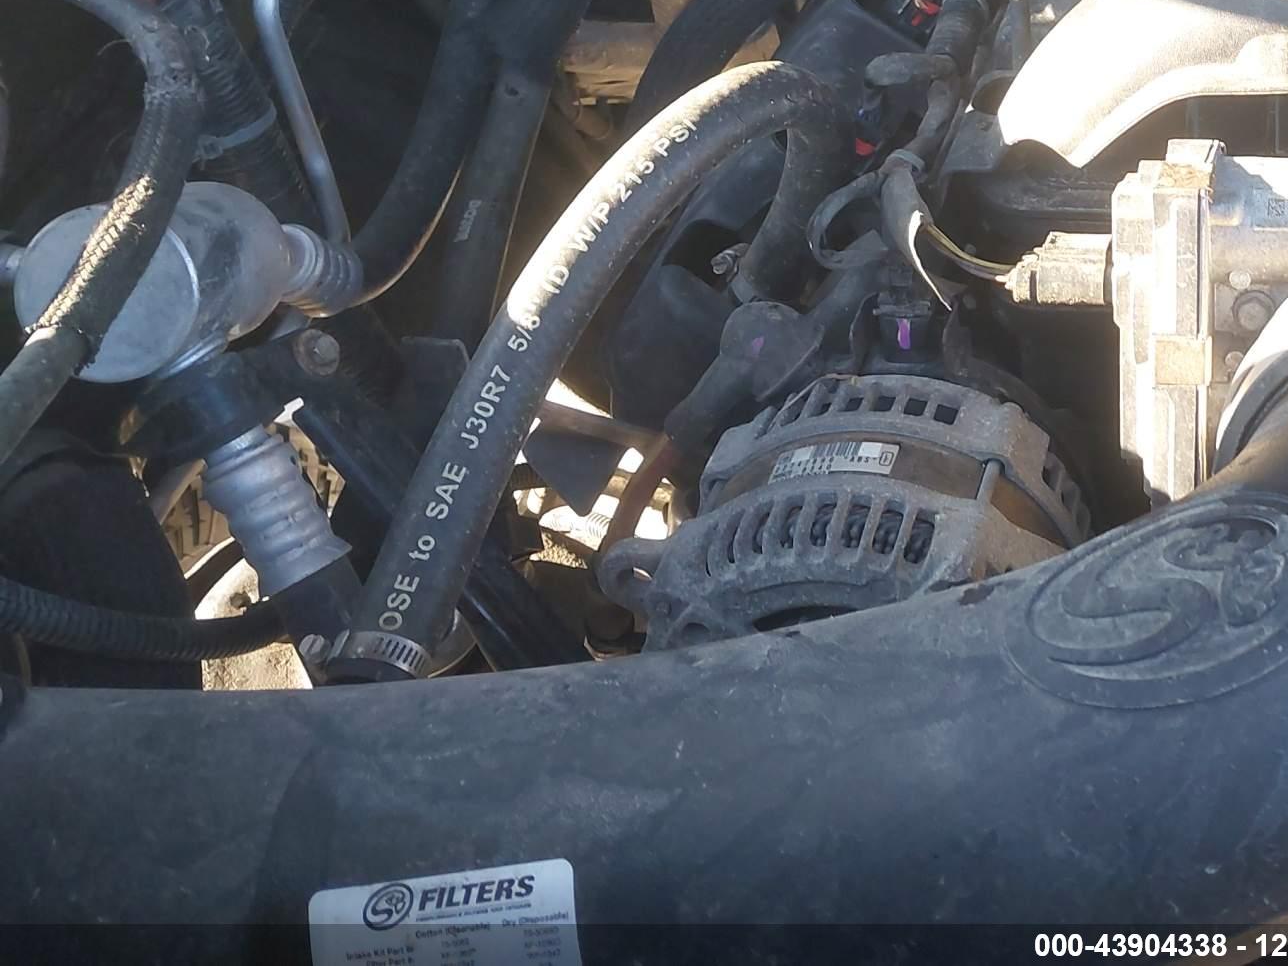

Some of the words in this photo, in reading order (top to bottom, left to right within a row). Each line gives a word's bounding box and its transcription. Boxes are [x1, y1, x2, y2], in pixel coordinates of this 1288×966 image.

[378, 573, 420, 631] OSE
[410, 535, 436, 562] to
[426, 462, 467, 521] SAE
[460, 365, 512, 450] J30R7
[575, 201, 611, 253] W/P
[618, 158, 656, 203] 215
[657, 118, 700, 157] PSI
[418, 875, 534, 911] FILTERS
